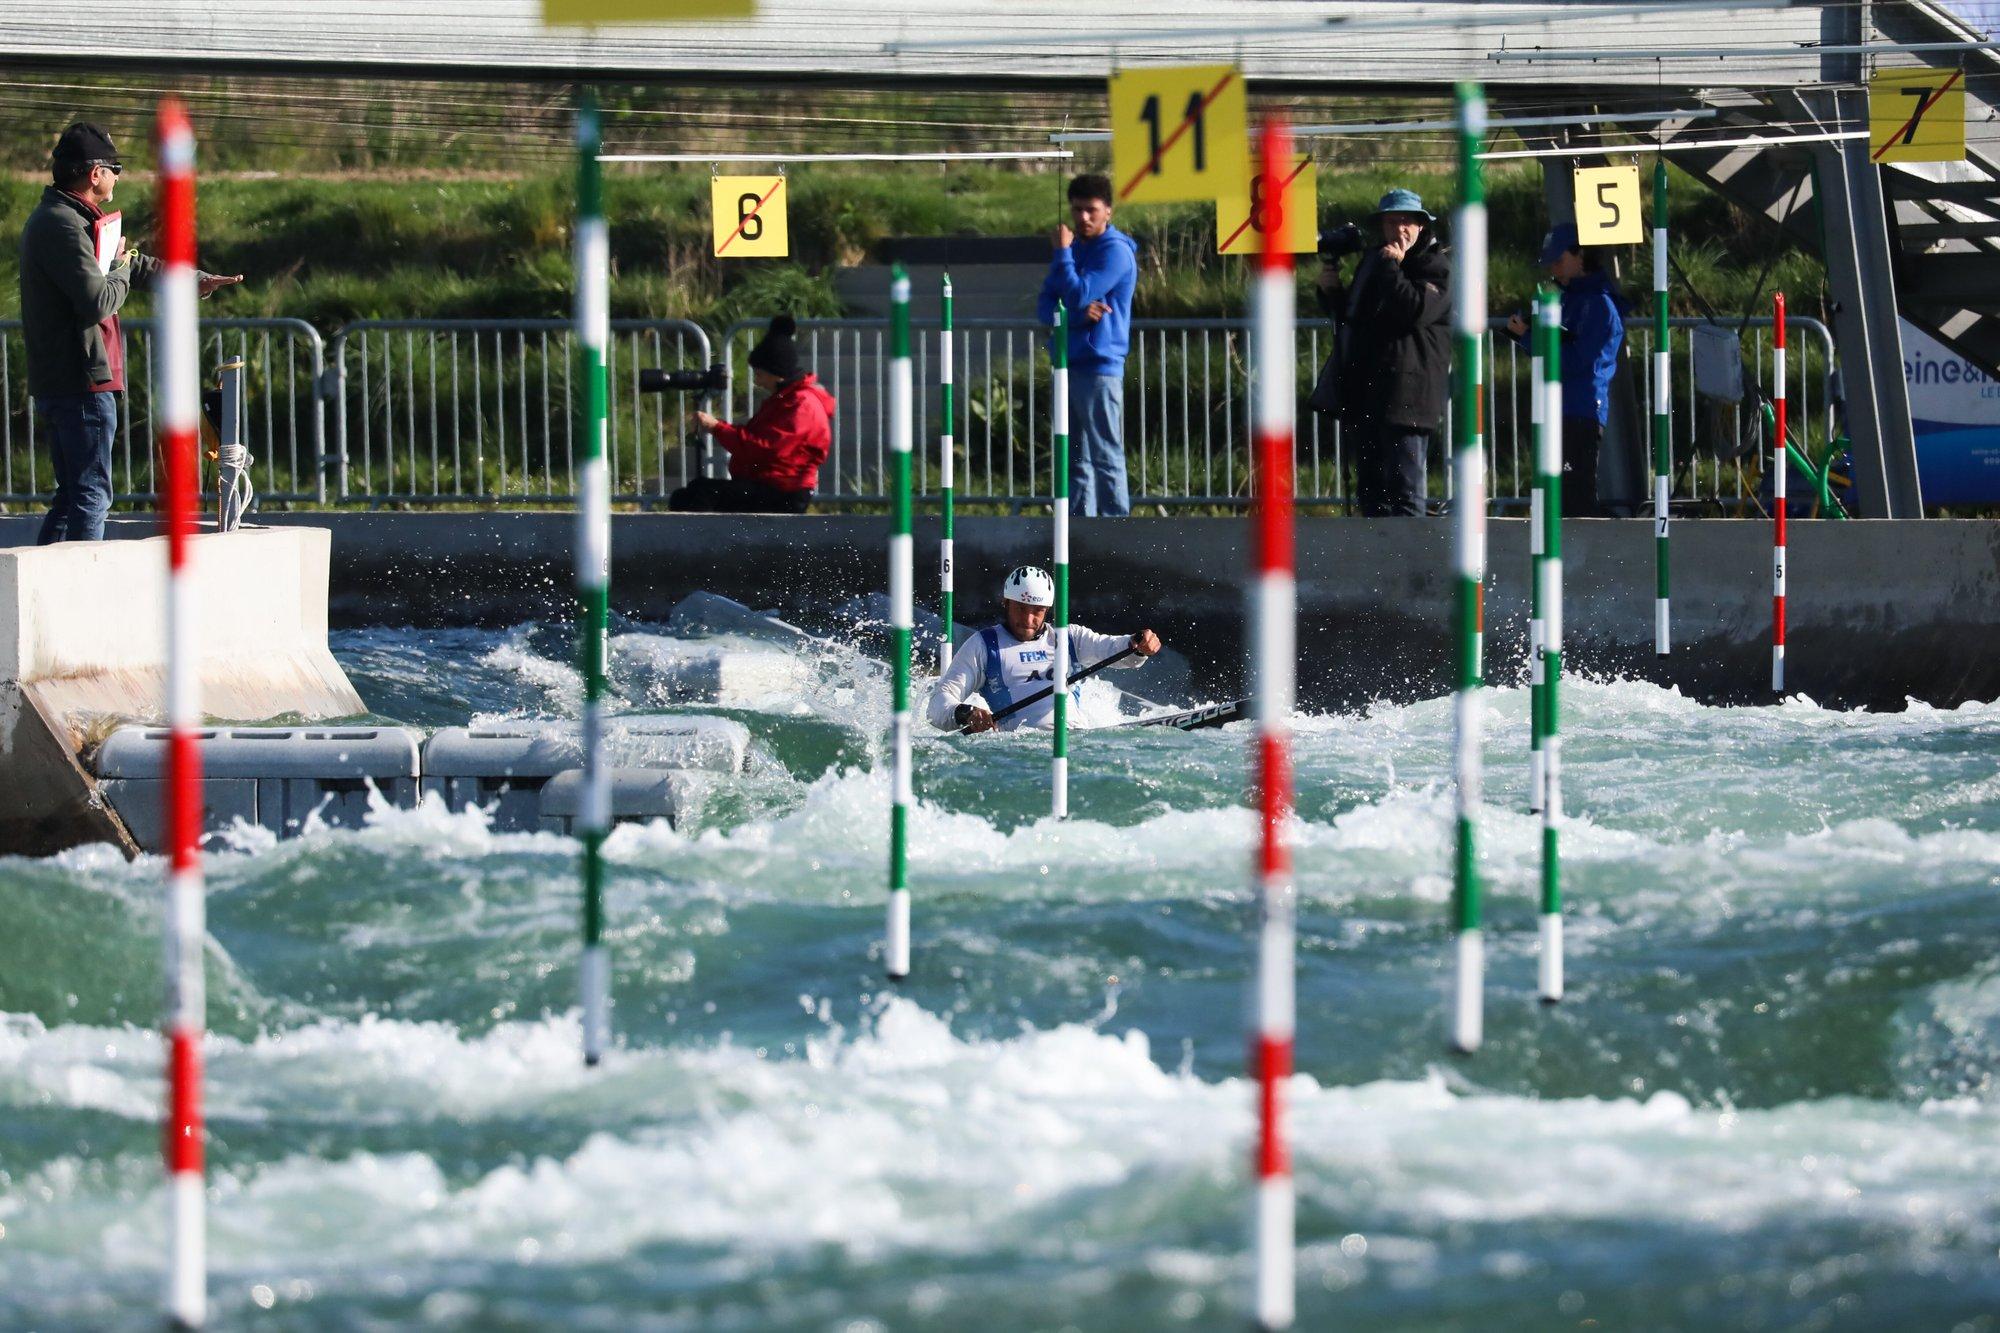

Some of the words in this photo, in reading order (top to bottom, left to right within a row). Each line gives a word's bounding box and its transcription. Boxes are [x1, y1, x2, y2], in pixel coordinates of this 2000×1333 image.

[1900, 86, 1933, 145] 7
[1138, 91, 1207, 176] 11
[737, 192, 763, 241] 6
[1250, 172, 1284, 235] 8
[1597, 182, 1621, 229] 5
[1660, 518, 1667, 533] 7
[944, 559, 950, 573] 6
[1776, 564, 1783, 579] 5
[1019, 650, 1047, 663] FFCK
[1536, 644, 1545, 661] 8
